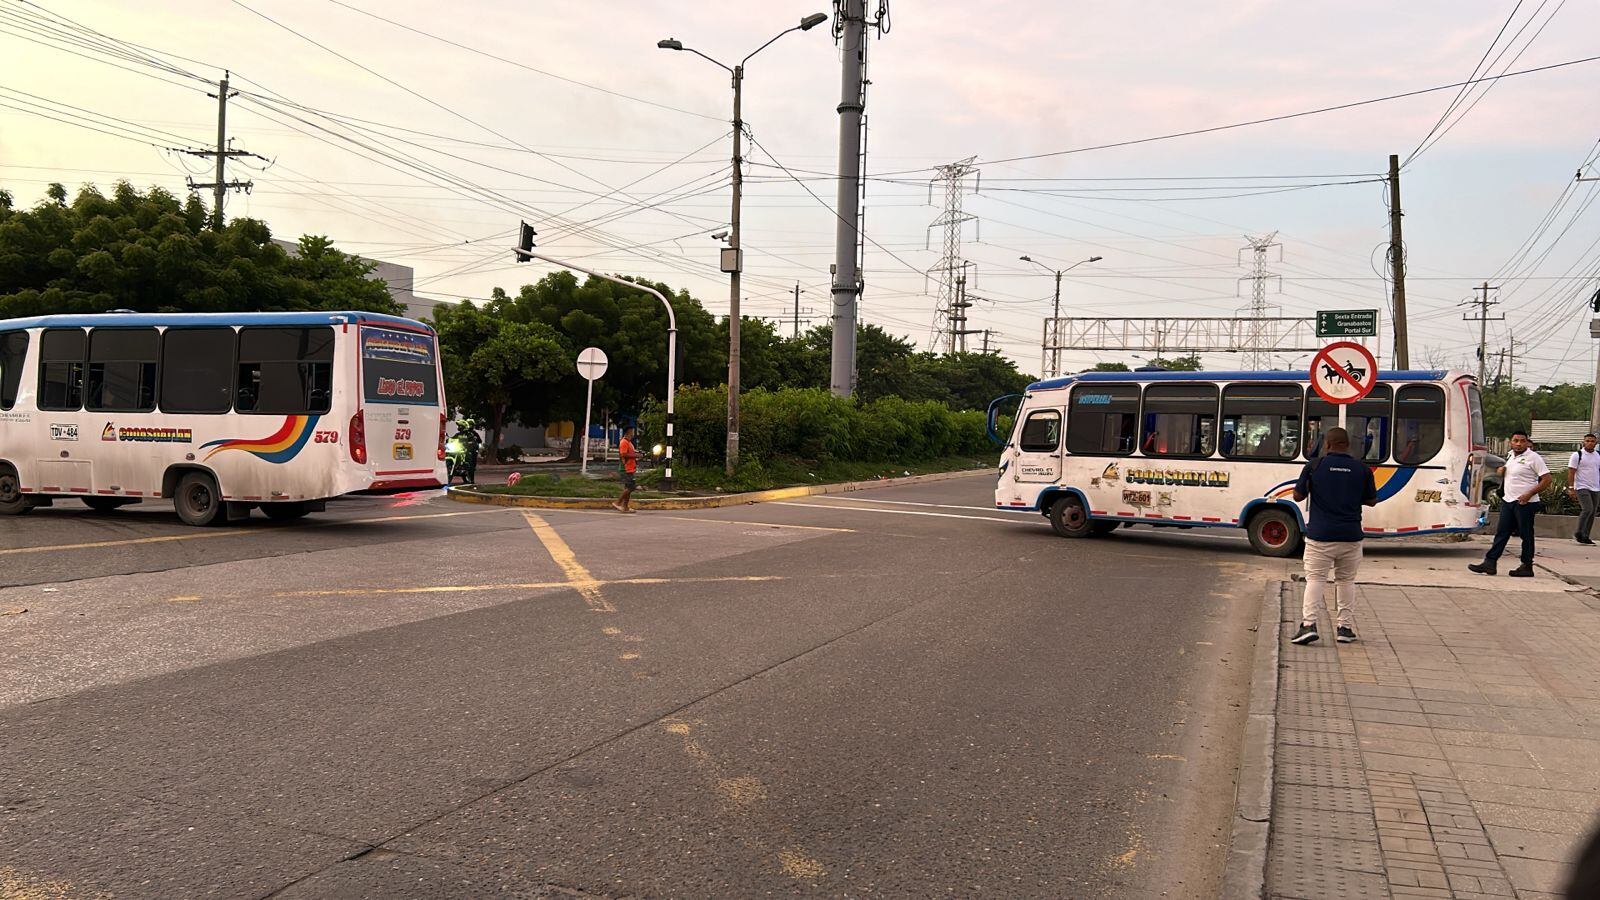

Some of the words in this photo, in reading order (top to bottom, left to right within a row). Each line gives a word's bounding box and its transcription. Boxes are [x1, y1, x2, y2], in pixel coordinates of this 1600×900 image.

[314, 431, 338, 443] 579
[395, 428, 411, 440] 579
[1415, 489, 1442, 503] 574
